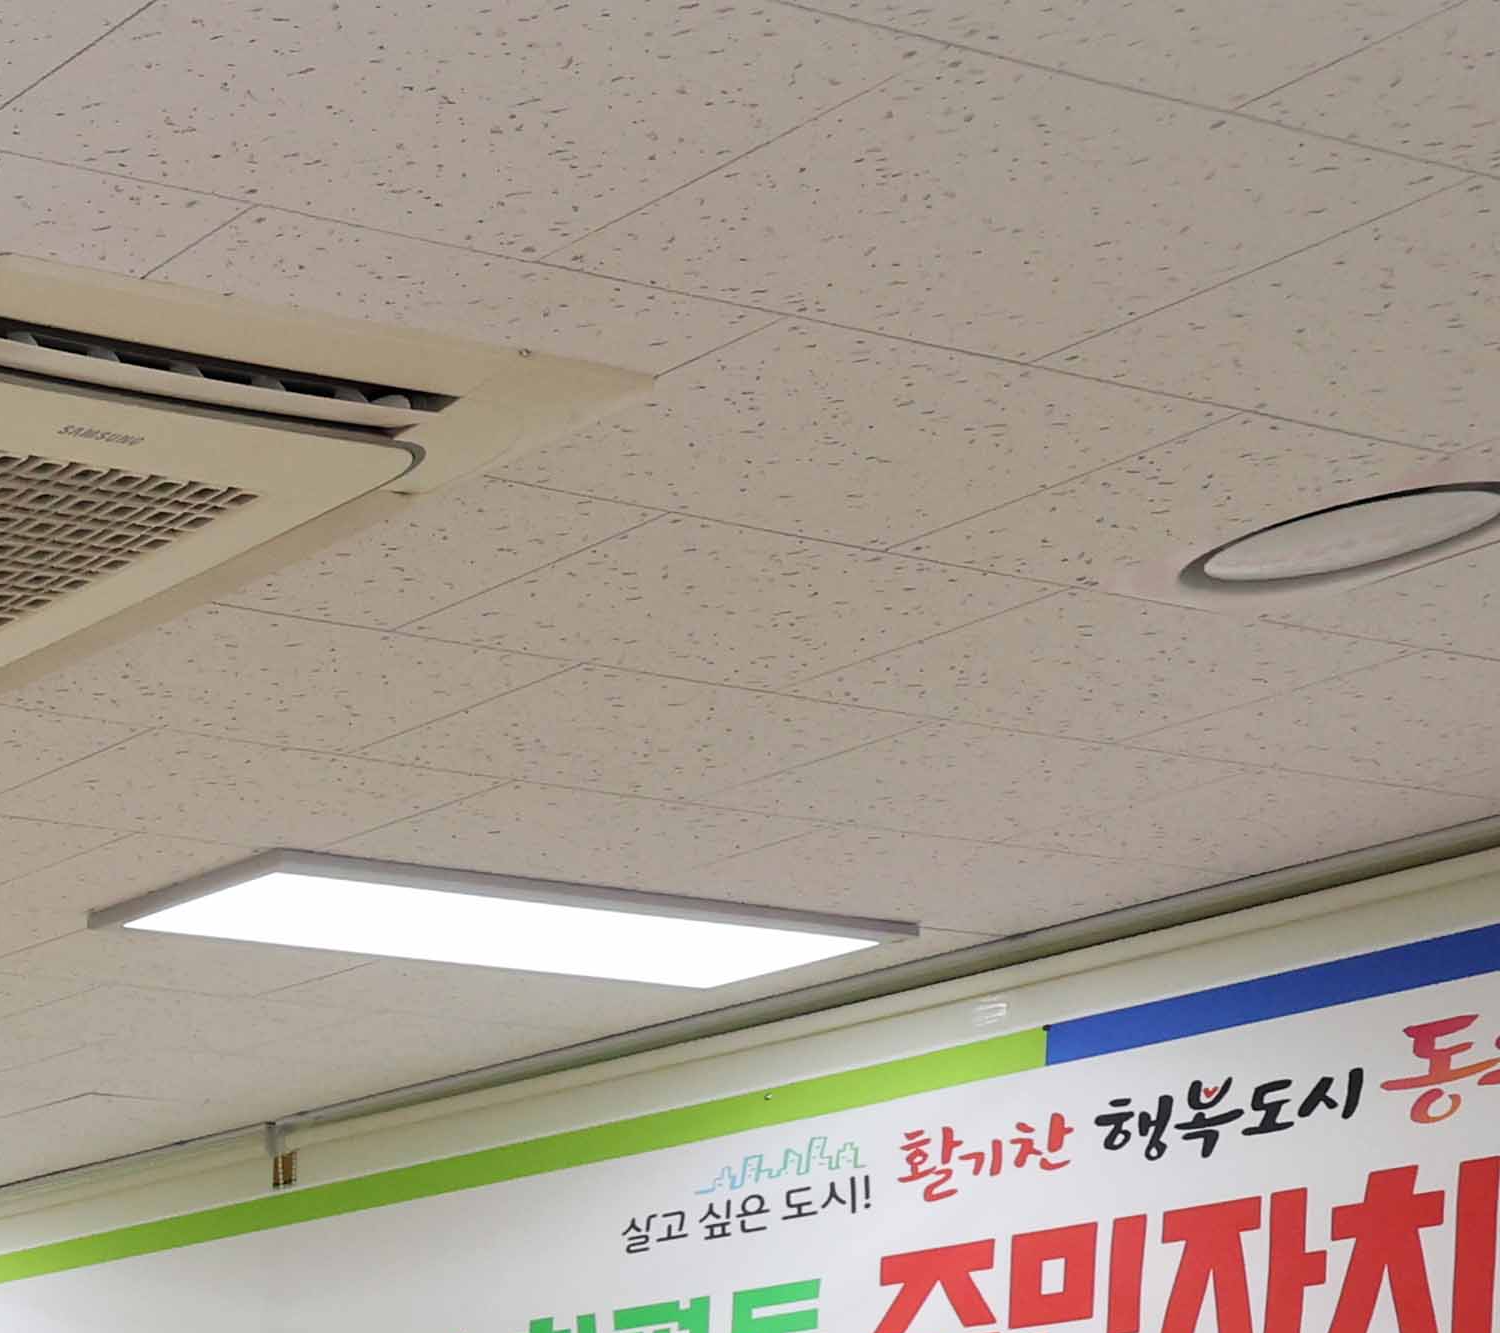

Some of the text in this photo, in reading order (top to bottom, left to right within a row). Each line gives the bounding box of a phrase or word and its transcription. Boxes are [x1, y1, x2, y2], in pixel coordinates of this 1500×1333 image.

[897, 1013, 1500, 1203] 활기찬 행복도시 동
[621, 1174, 873, 1255] 살고 싶은 도시!
